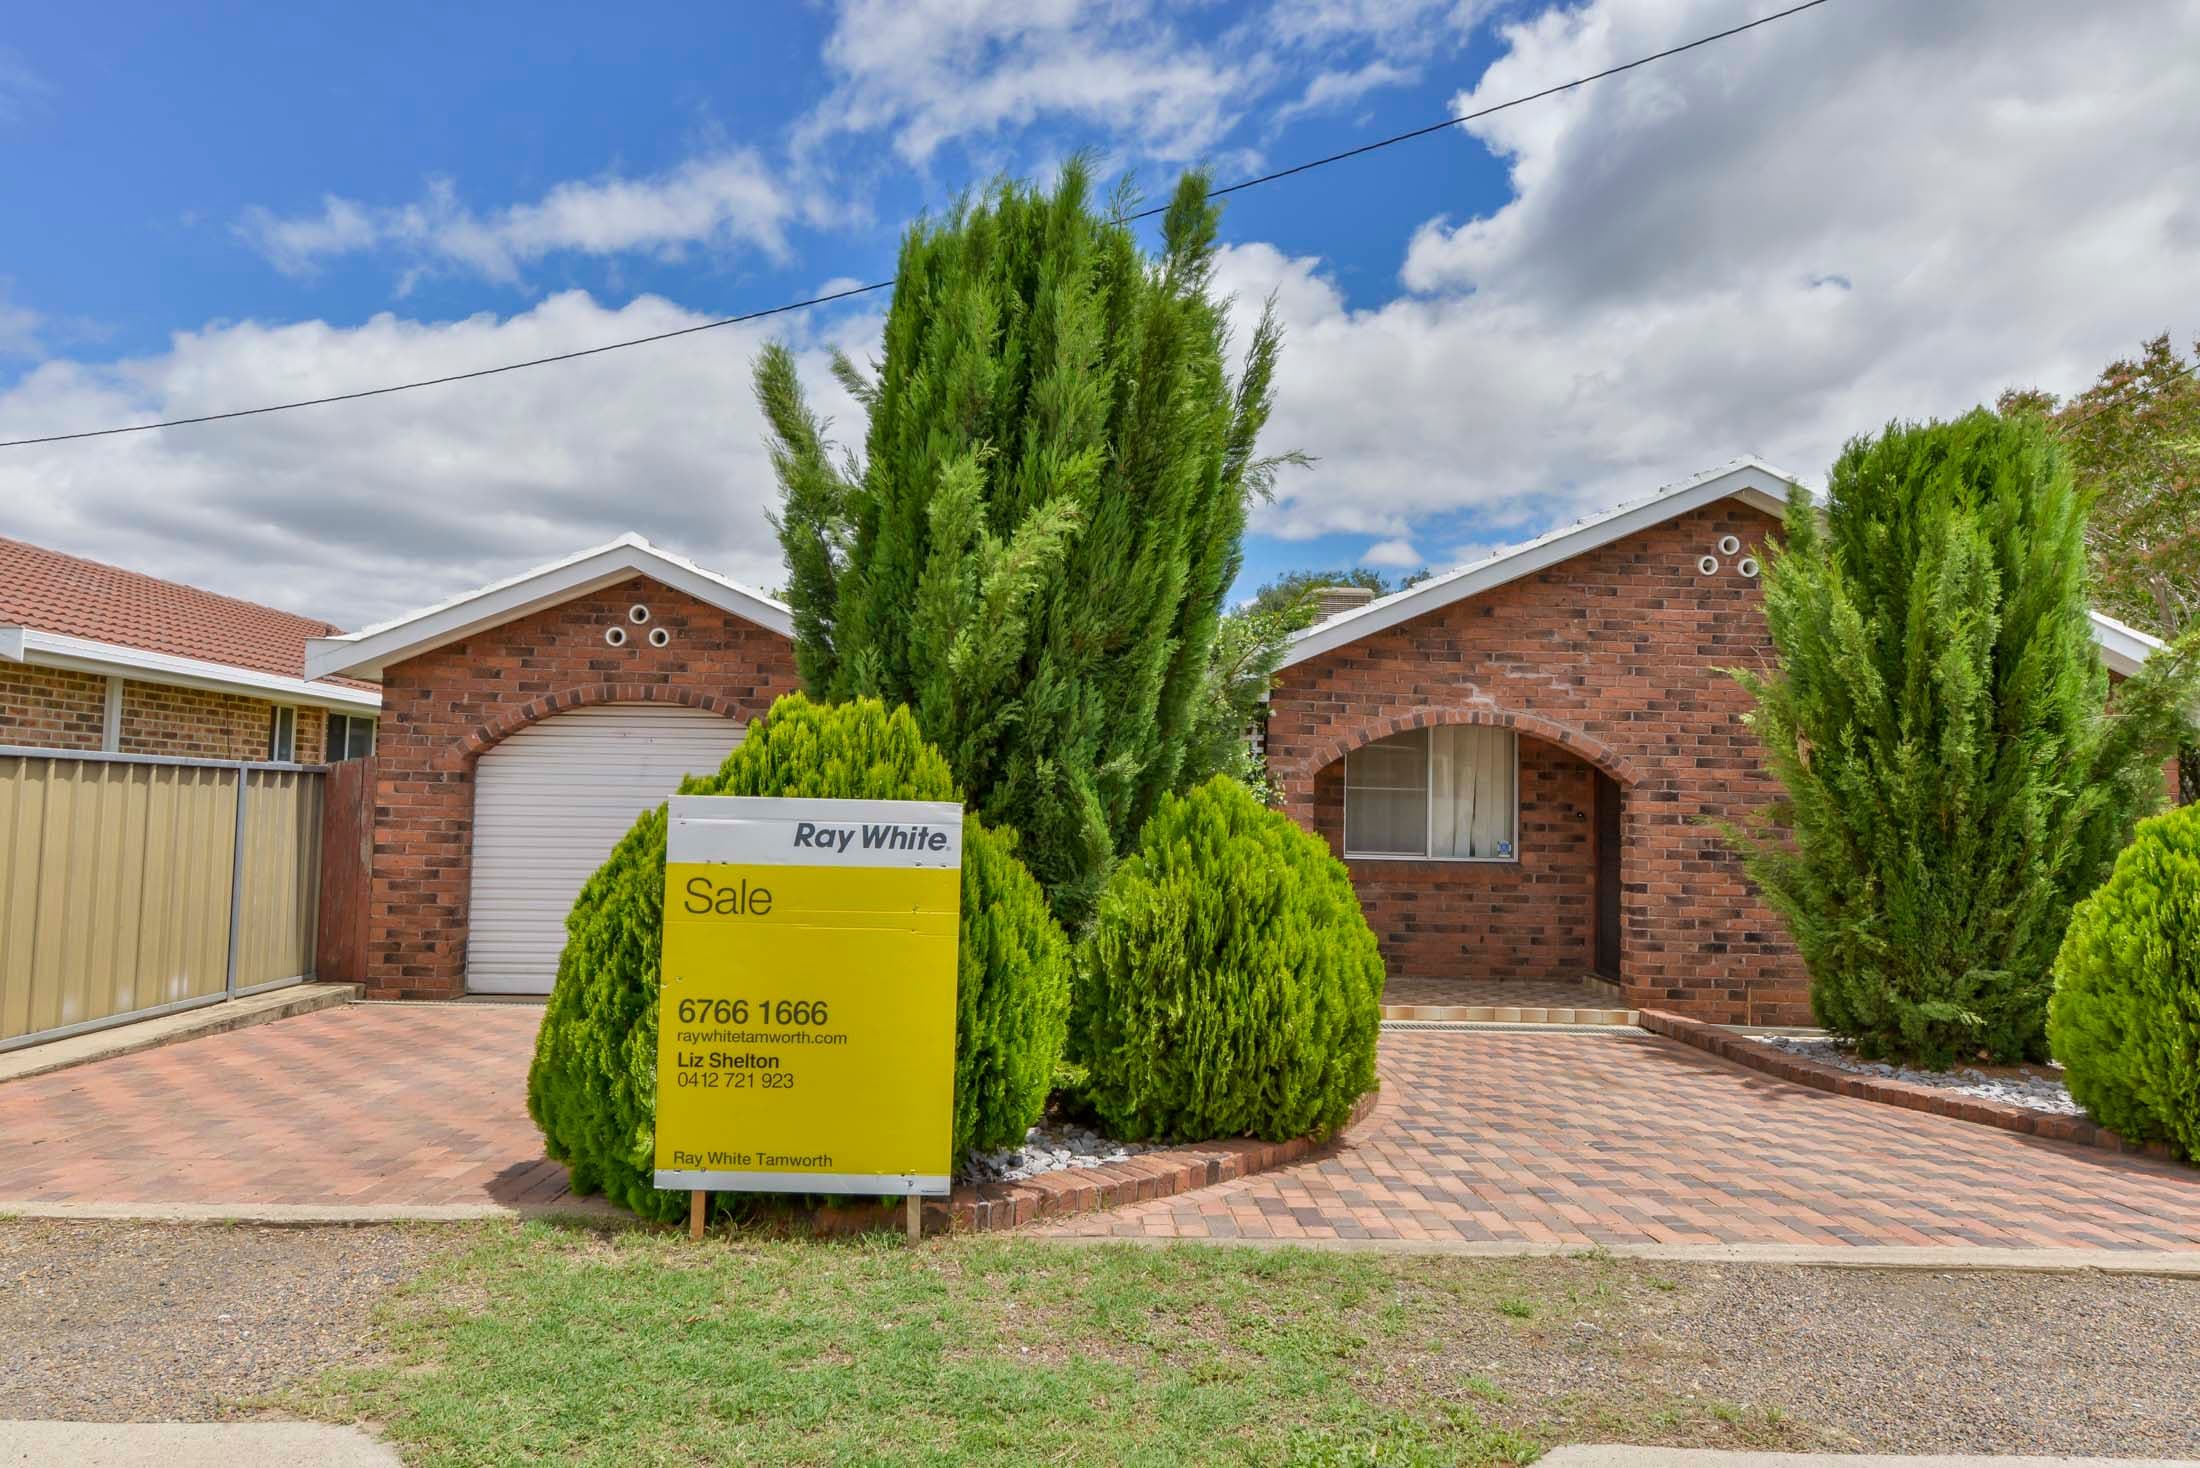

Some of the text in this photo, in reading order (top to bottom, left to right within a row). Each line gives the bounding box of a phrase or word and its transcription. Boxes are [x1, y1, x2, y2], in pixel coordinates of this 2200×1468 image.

[793, 822, 856, 853] Ray
[684, 876, 773, 916] Sale
[678, 998, 829, 1027] 6766 1666
[677, 1029, 848, 1046] raywhitetamworth.com
[677, 1052, 780, 1070] Liz Shelton
[677, 1071, 795, 1089] 0412 721 923
[673, 1151, 833, 1169] Ray White Tamworth
